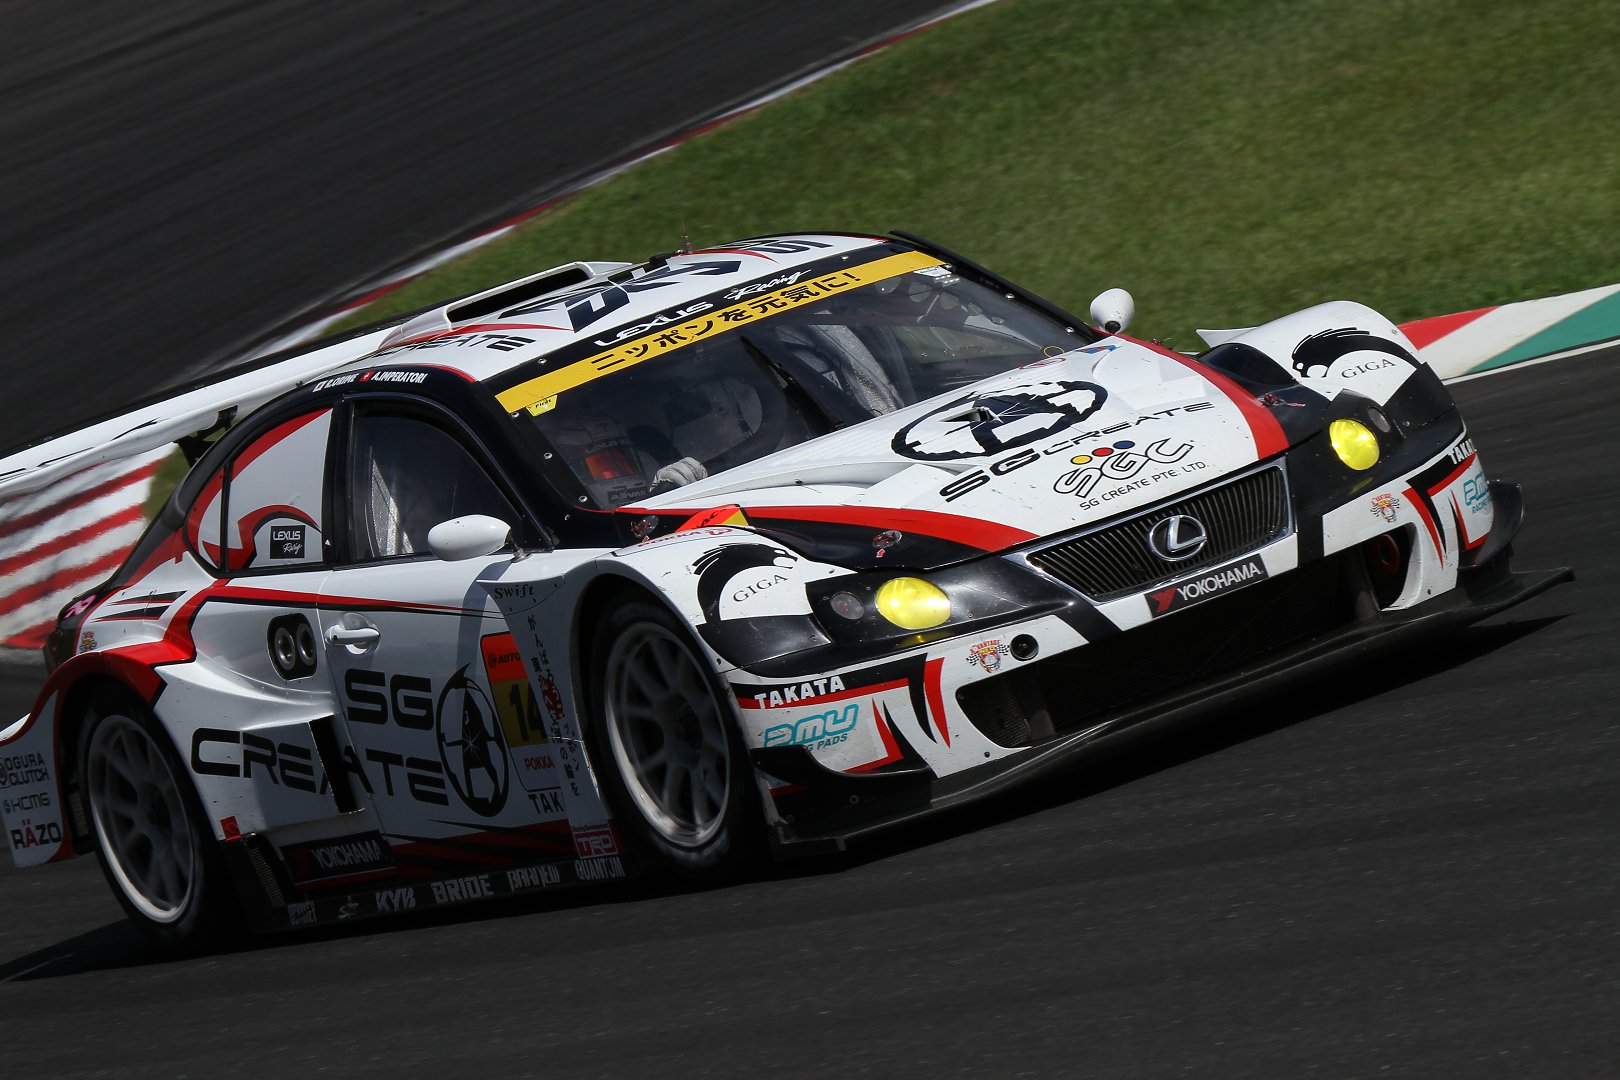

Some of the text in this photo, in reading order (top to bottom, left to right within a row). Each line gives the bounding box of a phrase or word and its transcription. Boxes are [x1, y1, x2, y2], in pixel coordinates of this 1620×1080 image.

[594, 269, 812, 347] LEXUS Racing
[1341, 358, 1396, 379] GIGA
[940, 401, 1216, 503] SG CREATE
[1079, 460, 1210, 512] SG CREATE PTE. LTD.
[273, 531, 300, 540] LEXUS
[494, 584, 534, 599] Swift
[733, 573, 789, 604] GIGA
[1177, 562, 1260, 600] YOKOHAMA
[344, 668, 435, 731] SG
[754, 675, 846, 710] TAKATA
[817, 733, 848, 750] PADS
[4, 752, 46, 771] OGURA
[524, 755, 556, 771] POKKA
[9, 768, 50, 786] CLUTCH
[11, 819, 62, 849] RÄZO
[576, 834, 613, 856] TRD
[310, 840, 382, 870] YOKOHAMA
[575, 856, 626, 881] QUANTUM
[430, 874, 494, 905] BRIDE
